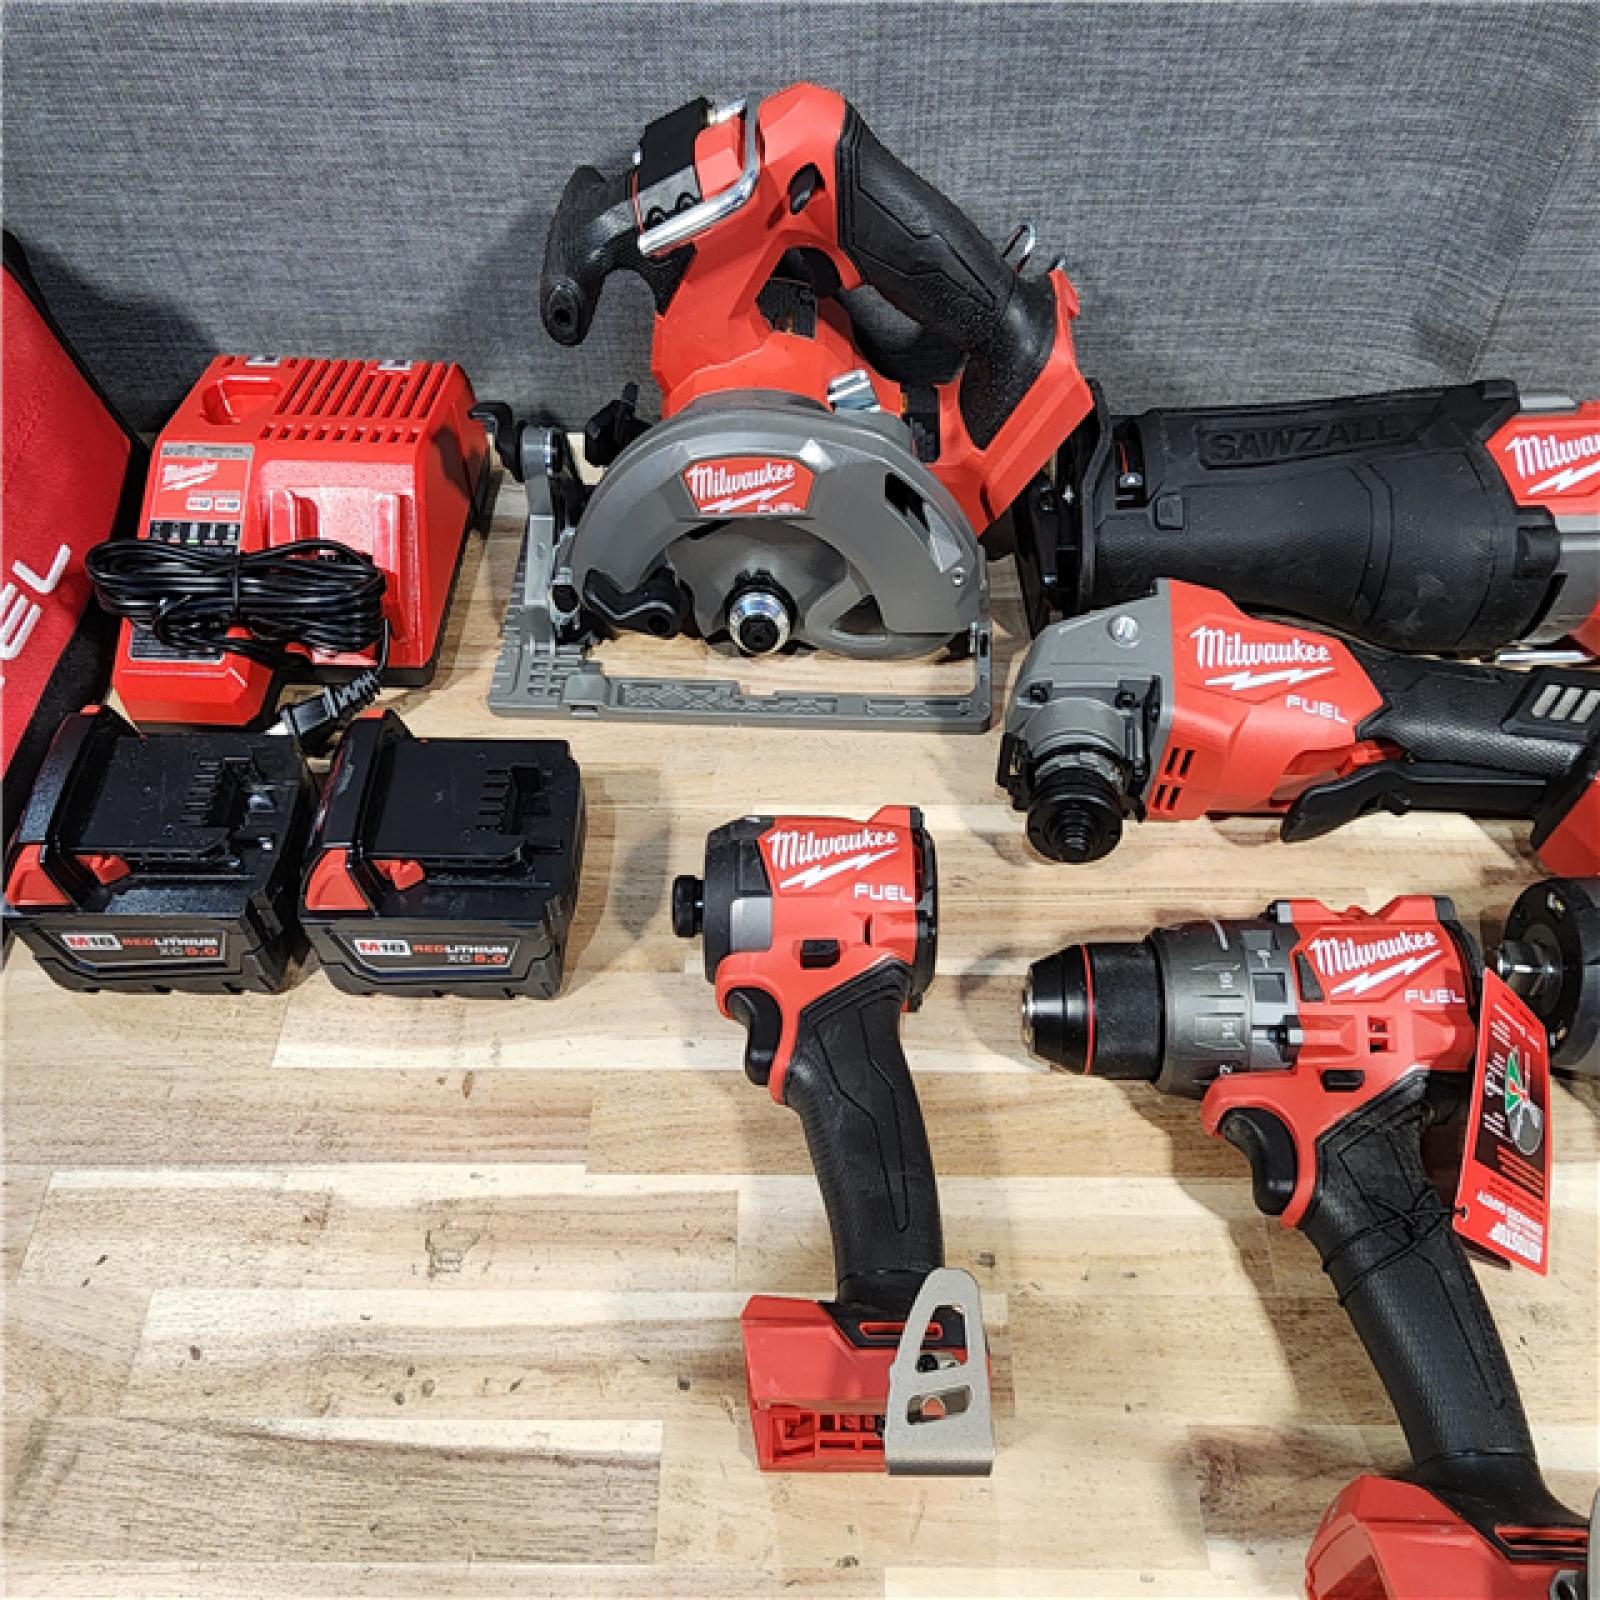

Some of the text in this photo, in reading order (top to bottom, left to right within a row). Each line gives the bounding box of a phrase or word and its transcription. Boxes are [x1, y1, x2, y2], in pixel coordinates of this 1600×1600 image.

[1204, 416, 1402, 463] SAWZALL
[687, 462, 795, 500] Milwaukee
[1190, 625, 1332, 668] Milwaukee
[1285, 694, 1349, 724] FUEL
[767, 829, 898, 871] Milwaukee
[854, 882, 913, 903] FUEL
[359, 942, 407, 953] M18
[1309, 931, 1439, 977] Milwaukee
[1404, 989, 1466, 1004] FUEL
